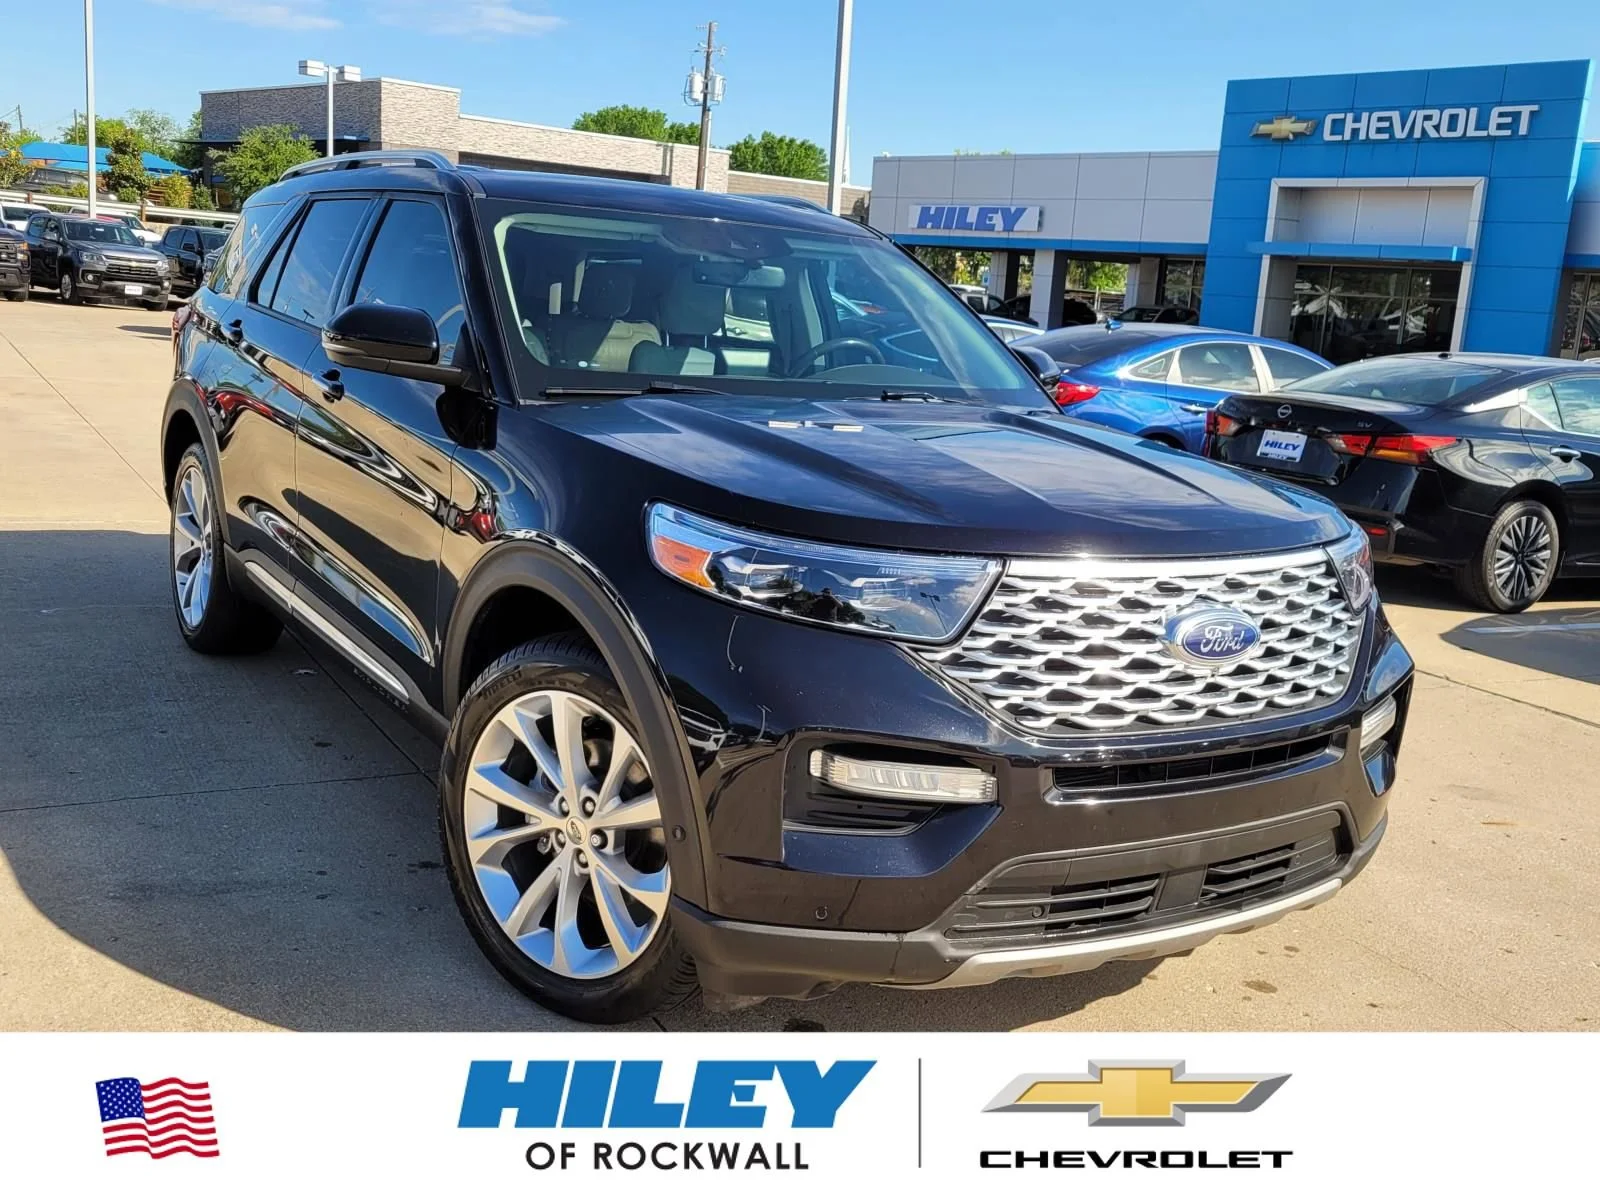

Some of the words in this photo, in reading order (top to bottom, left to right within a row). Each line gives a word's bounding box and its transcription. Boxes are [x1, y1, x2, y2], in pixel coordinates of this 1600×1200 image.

[1323, 105, 1540, 142] CHEVROLET
[917, 206, 1029, 232] HILEY
[1357, 421, 1373, 429] SV
[1264, 439, 1301, 452] HILEY
[1200, 625, 1245, 653] Ford
